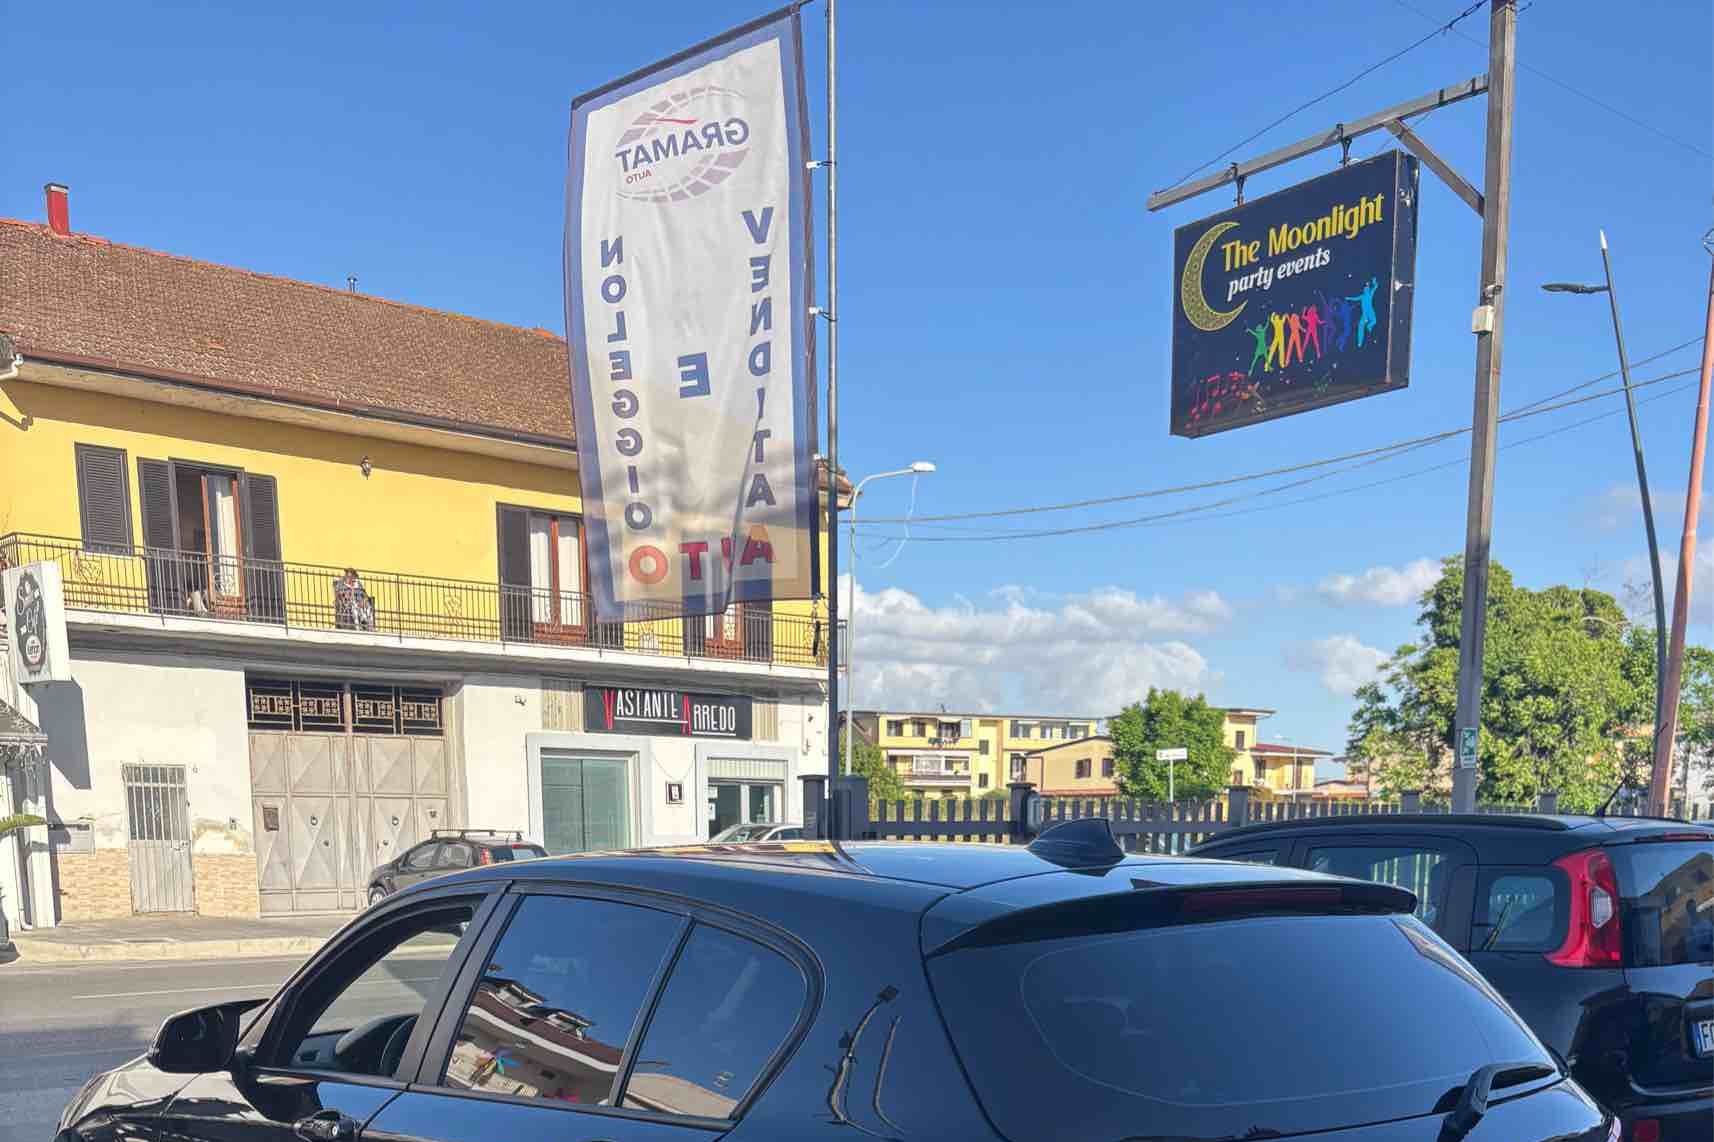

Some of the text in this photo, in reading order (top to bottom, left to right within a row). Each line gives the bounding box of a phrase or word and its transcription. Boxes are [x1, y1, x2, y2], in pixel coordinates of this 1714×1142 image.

[1221, 192, 1385, 272] The Moonlight
[1227, 248, 1331, 302] party events
[603, 689, 737, 736] VASTANTE ARREDO
